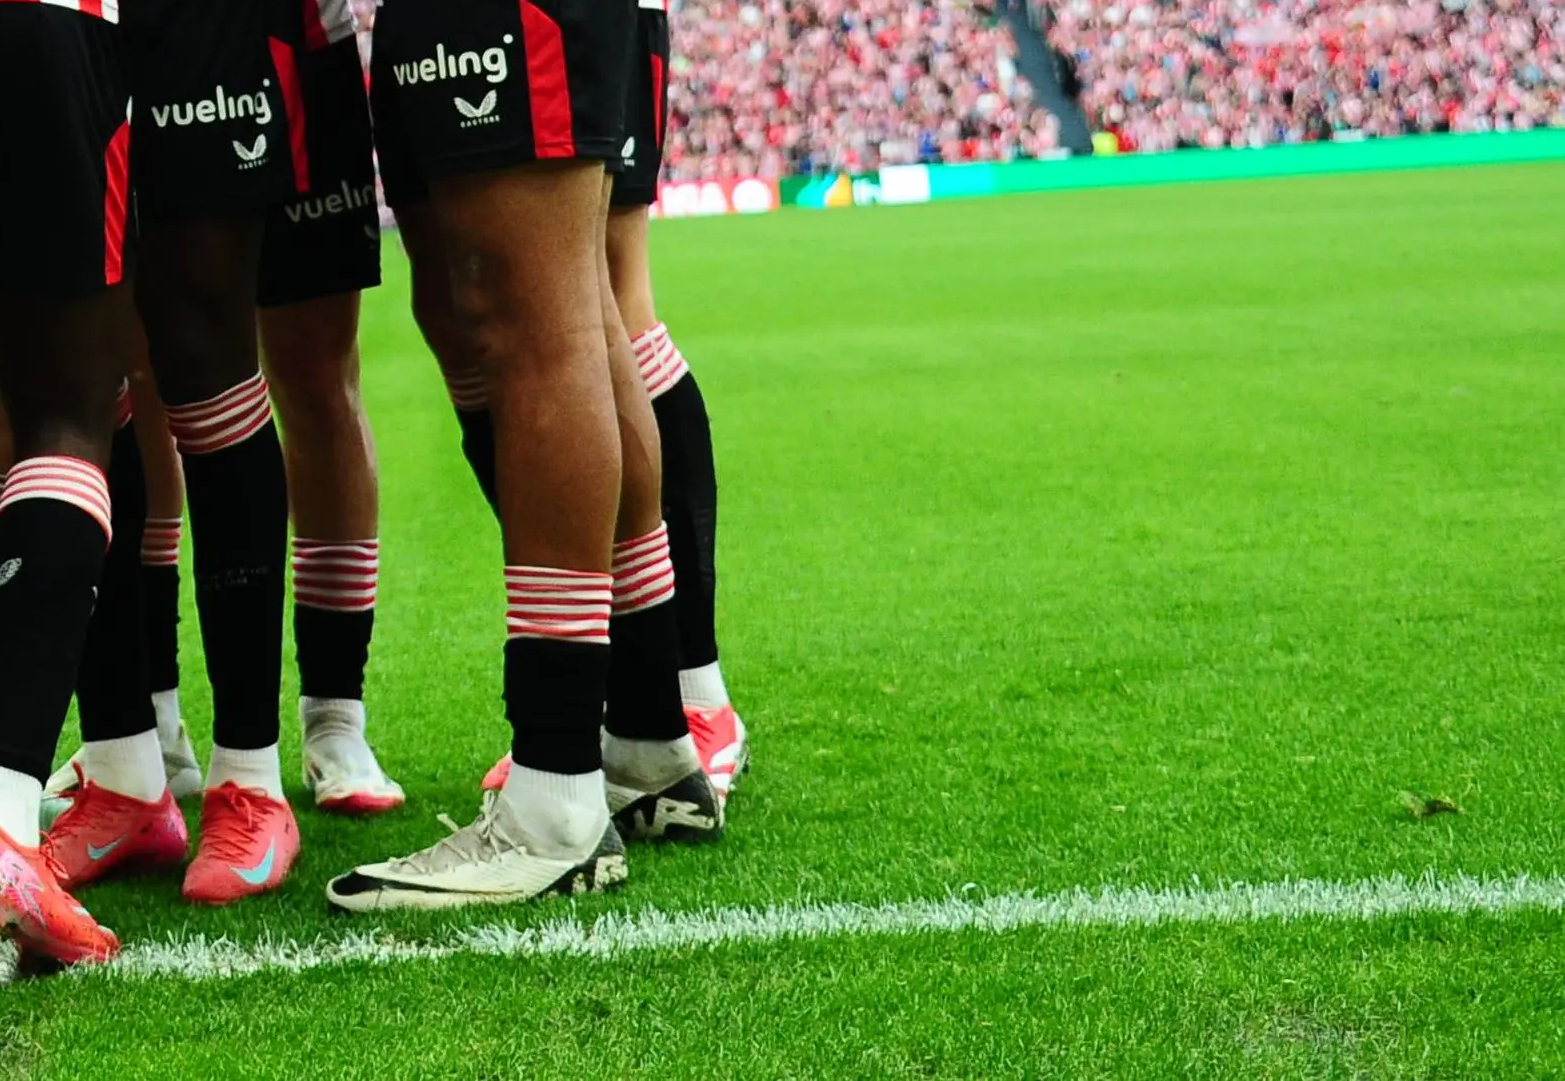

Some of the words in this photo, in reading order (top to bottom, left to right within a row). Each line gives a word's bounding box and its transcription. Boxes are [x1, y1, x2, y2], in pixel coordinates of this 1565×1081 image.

[392, 33, 514, 85] vueling
[151, 78, 272, 126] vueling
[285, 179, 376, 223] vuelin
